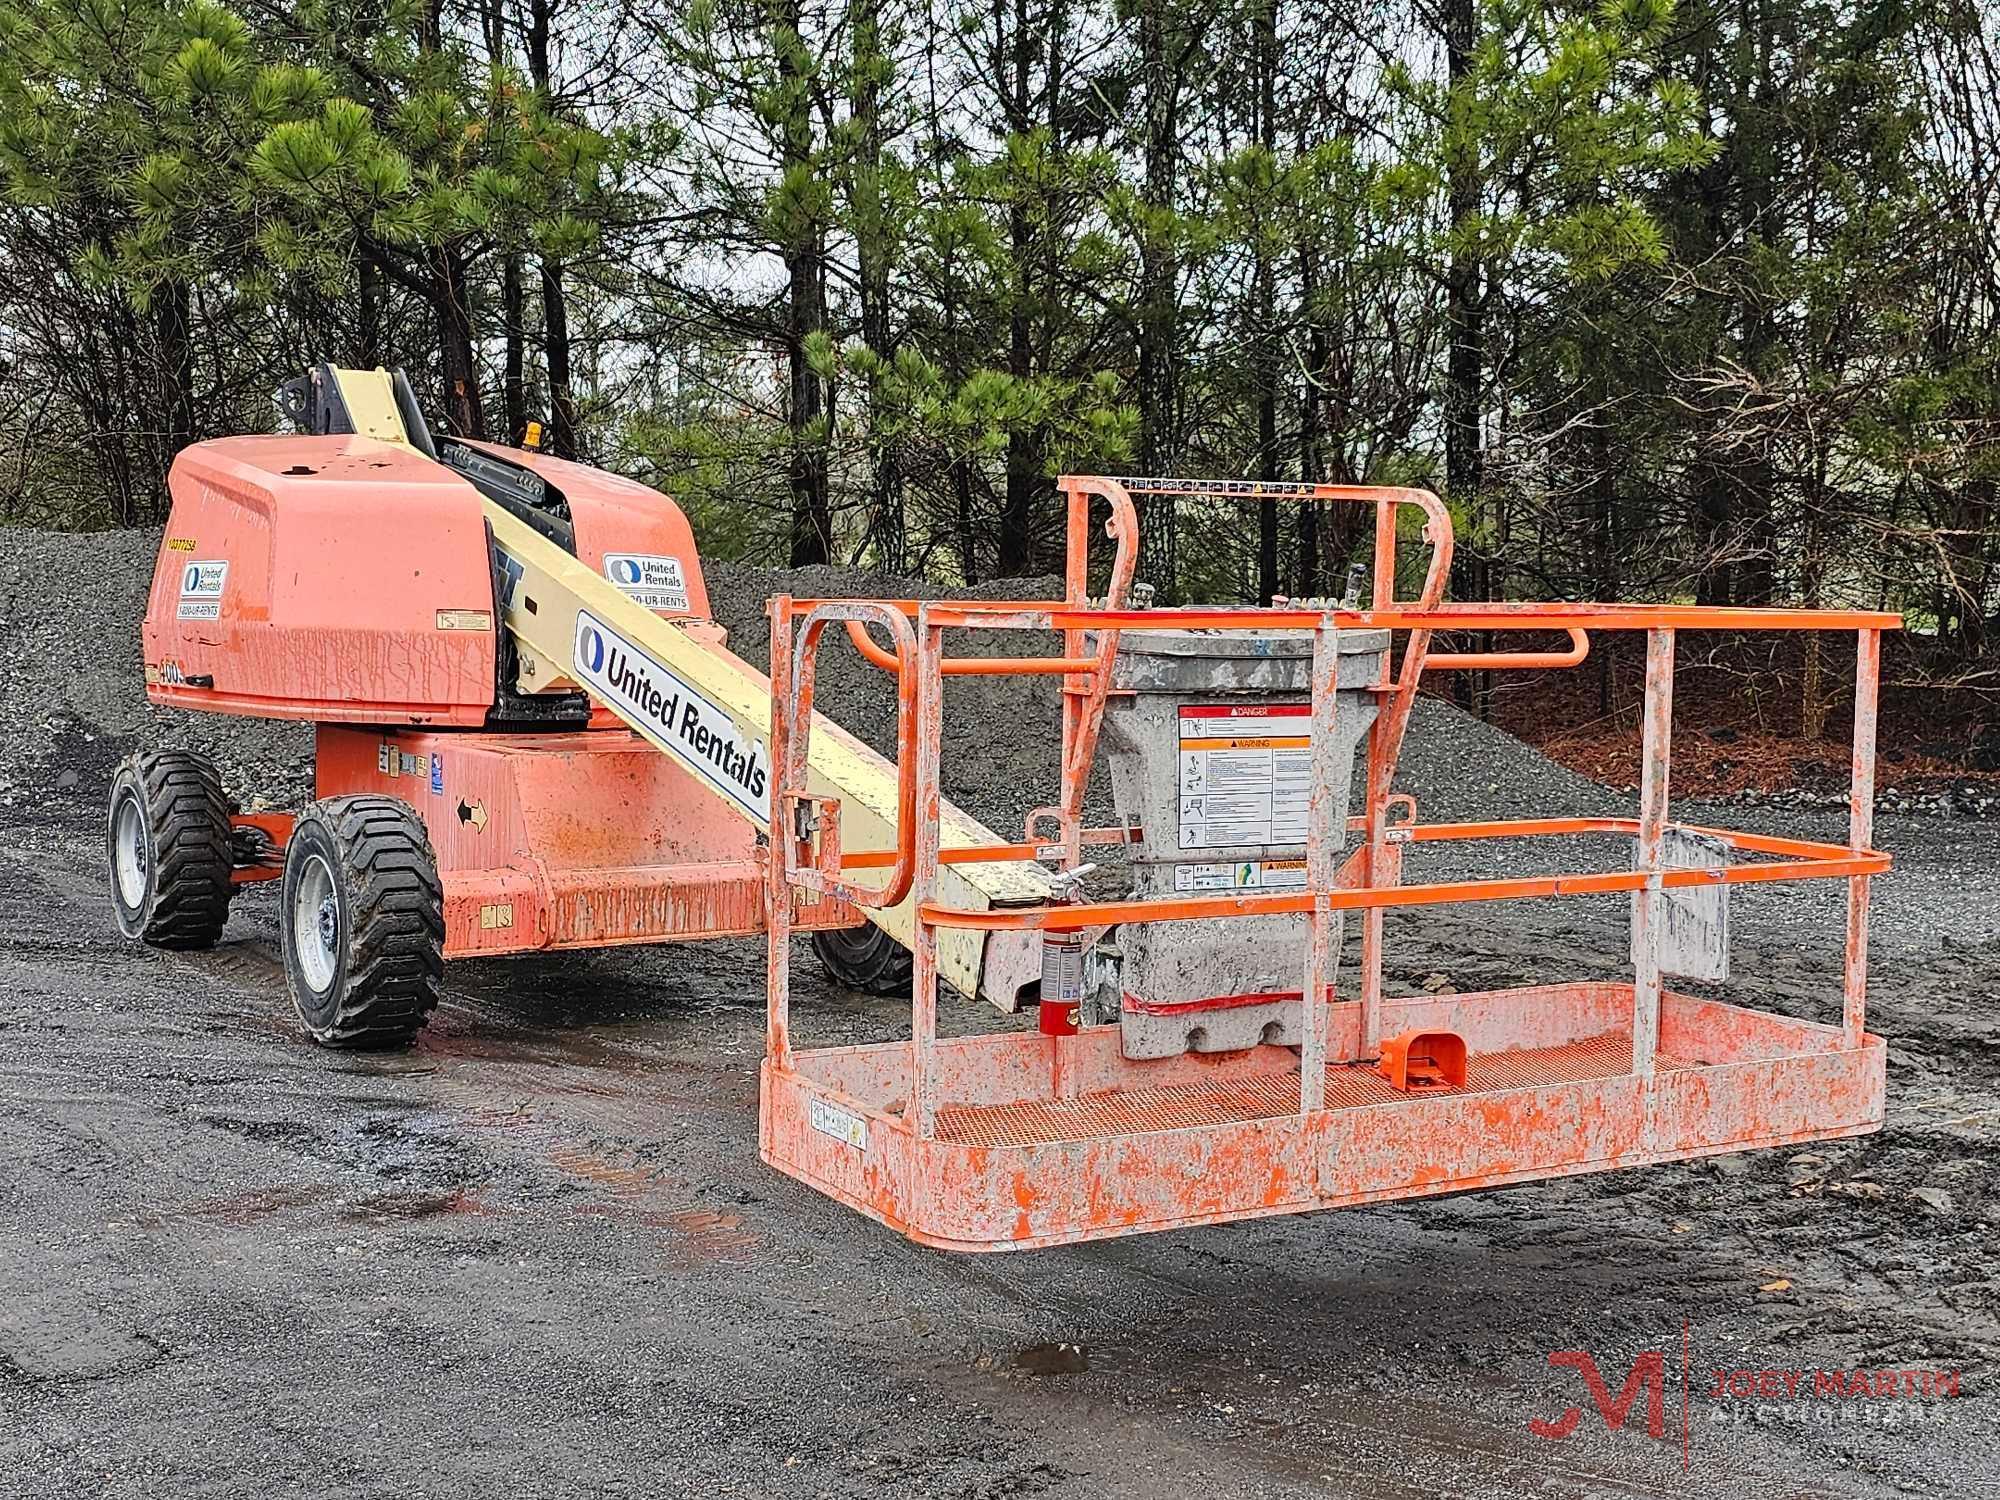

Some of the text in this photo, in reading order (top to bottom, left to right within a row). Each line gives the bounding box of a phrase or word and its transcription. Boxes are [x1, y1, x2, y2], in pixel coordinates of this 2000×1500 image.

[200, 566, 223, 579] United
[641, 561, 676, 575] United
[198, 579, 222, 592] Rentals
[644, 573, 682, 588] Rentals
[1237, 707, 1269, 717] DANGER
[607, 647, 767, 799] United Rentals
[1238, 739, 1271, 748] WARNING
